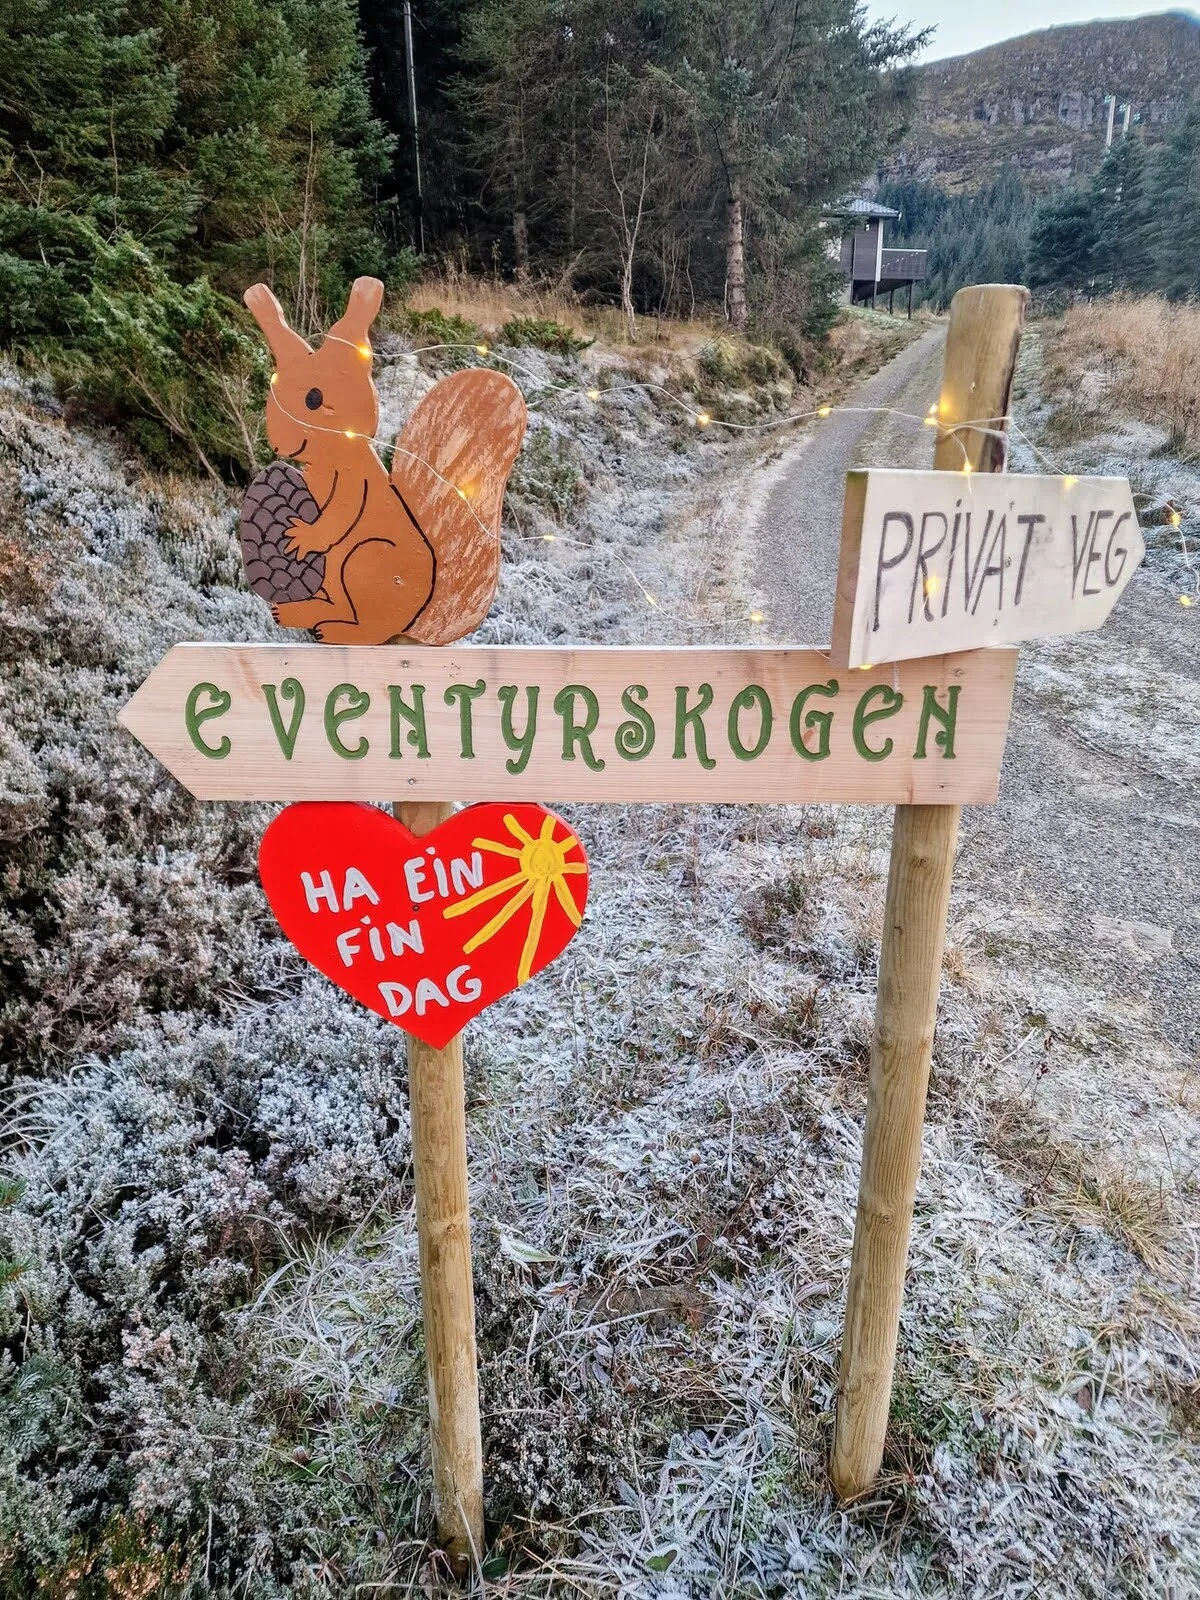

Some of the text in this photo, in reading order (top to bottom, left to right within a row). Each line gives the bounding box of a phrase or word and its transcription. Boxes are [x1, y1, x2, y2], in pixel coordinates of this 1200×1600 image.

[872, 499, 1133, 632] PRIVAT VEG
[301, 847, 484, 913] HA EIN
[336, 915, 424, 968] FIN
[378, 964, 482, 1017] DAG
